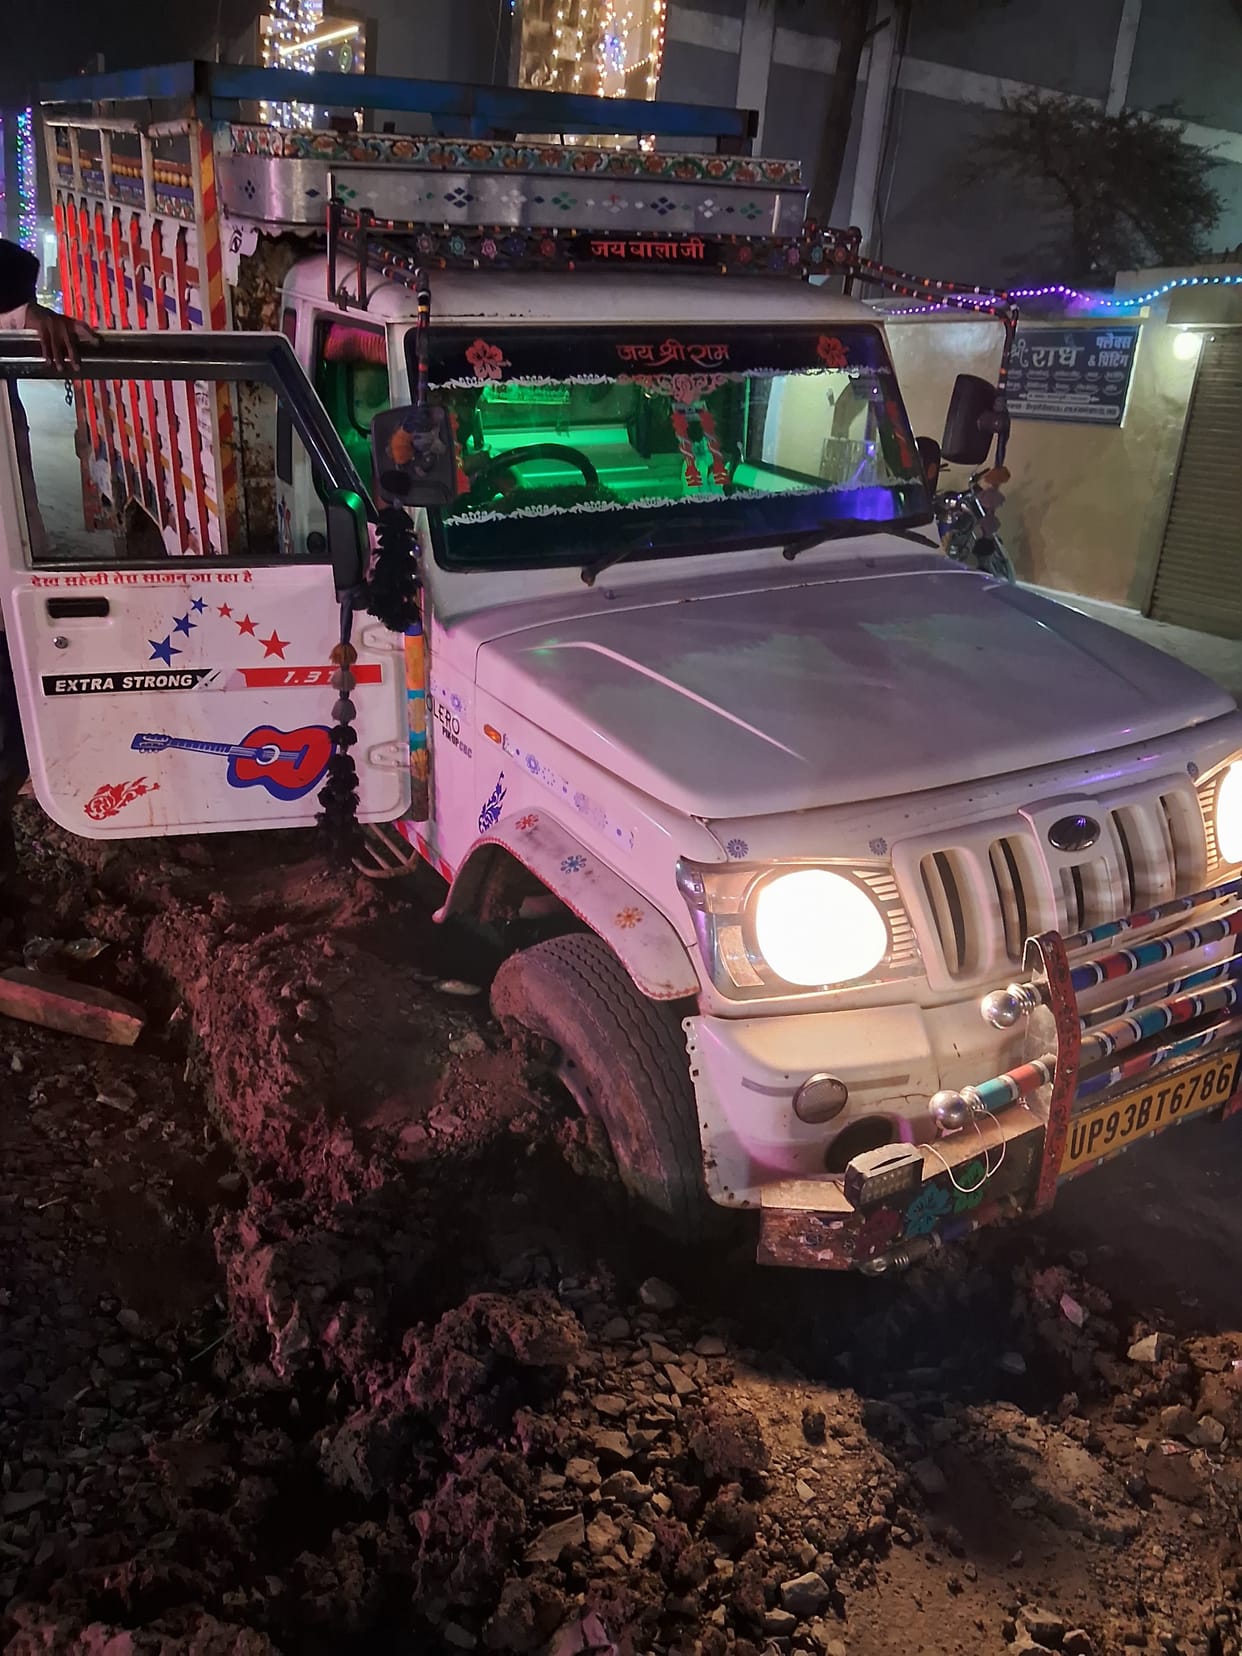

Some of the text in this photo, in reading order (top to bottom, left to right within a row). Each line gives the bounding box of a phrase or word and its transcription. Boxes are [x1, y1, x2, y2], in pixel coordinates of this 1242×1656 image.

[590, 236, 705, 260] जय बाला जी
[616, 338, 730, 368] जय श्री राम
[31, 574, 60, 588] देख
[64, 572, 109, 587] सहेली
[113, 571, 138, 585] तेरा
[215, 573, 240, 583] रहा
[243, 570, 253, 583] है
[55, 674, 193, 692] EXTRA STRONG
[1070, 1063, 1233, 1160] UP93BT6786
